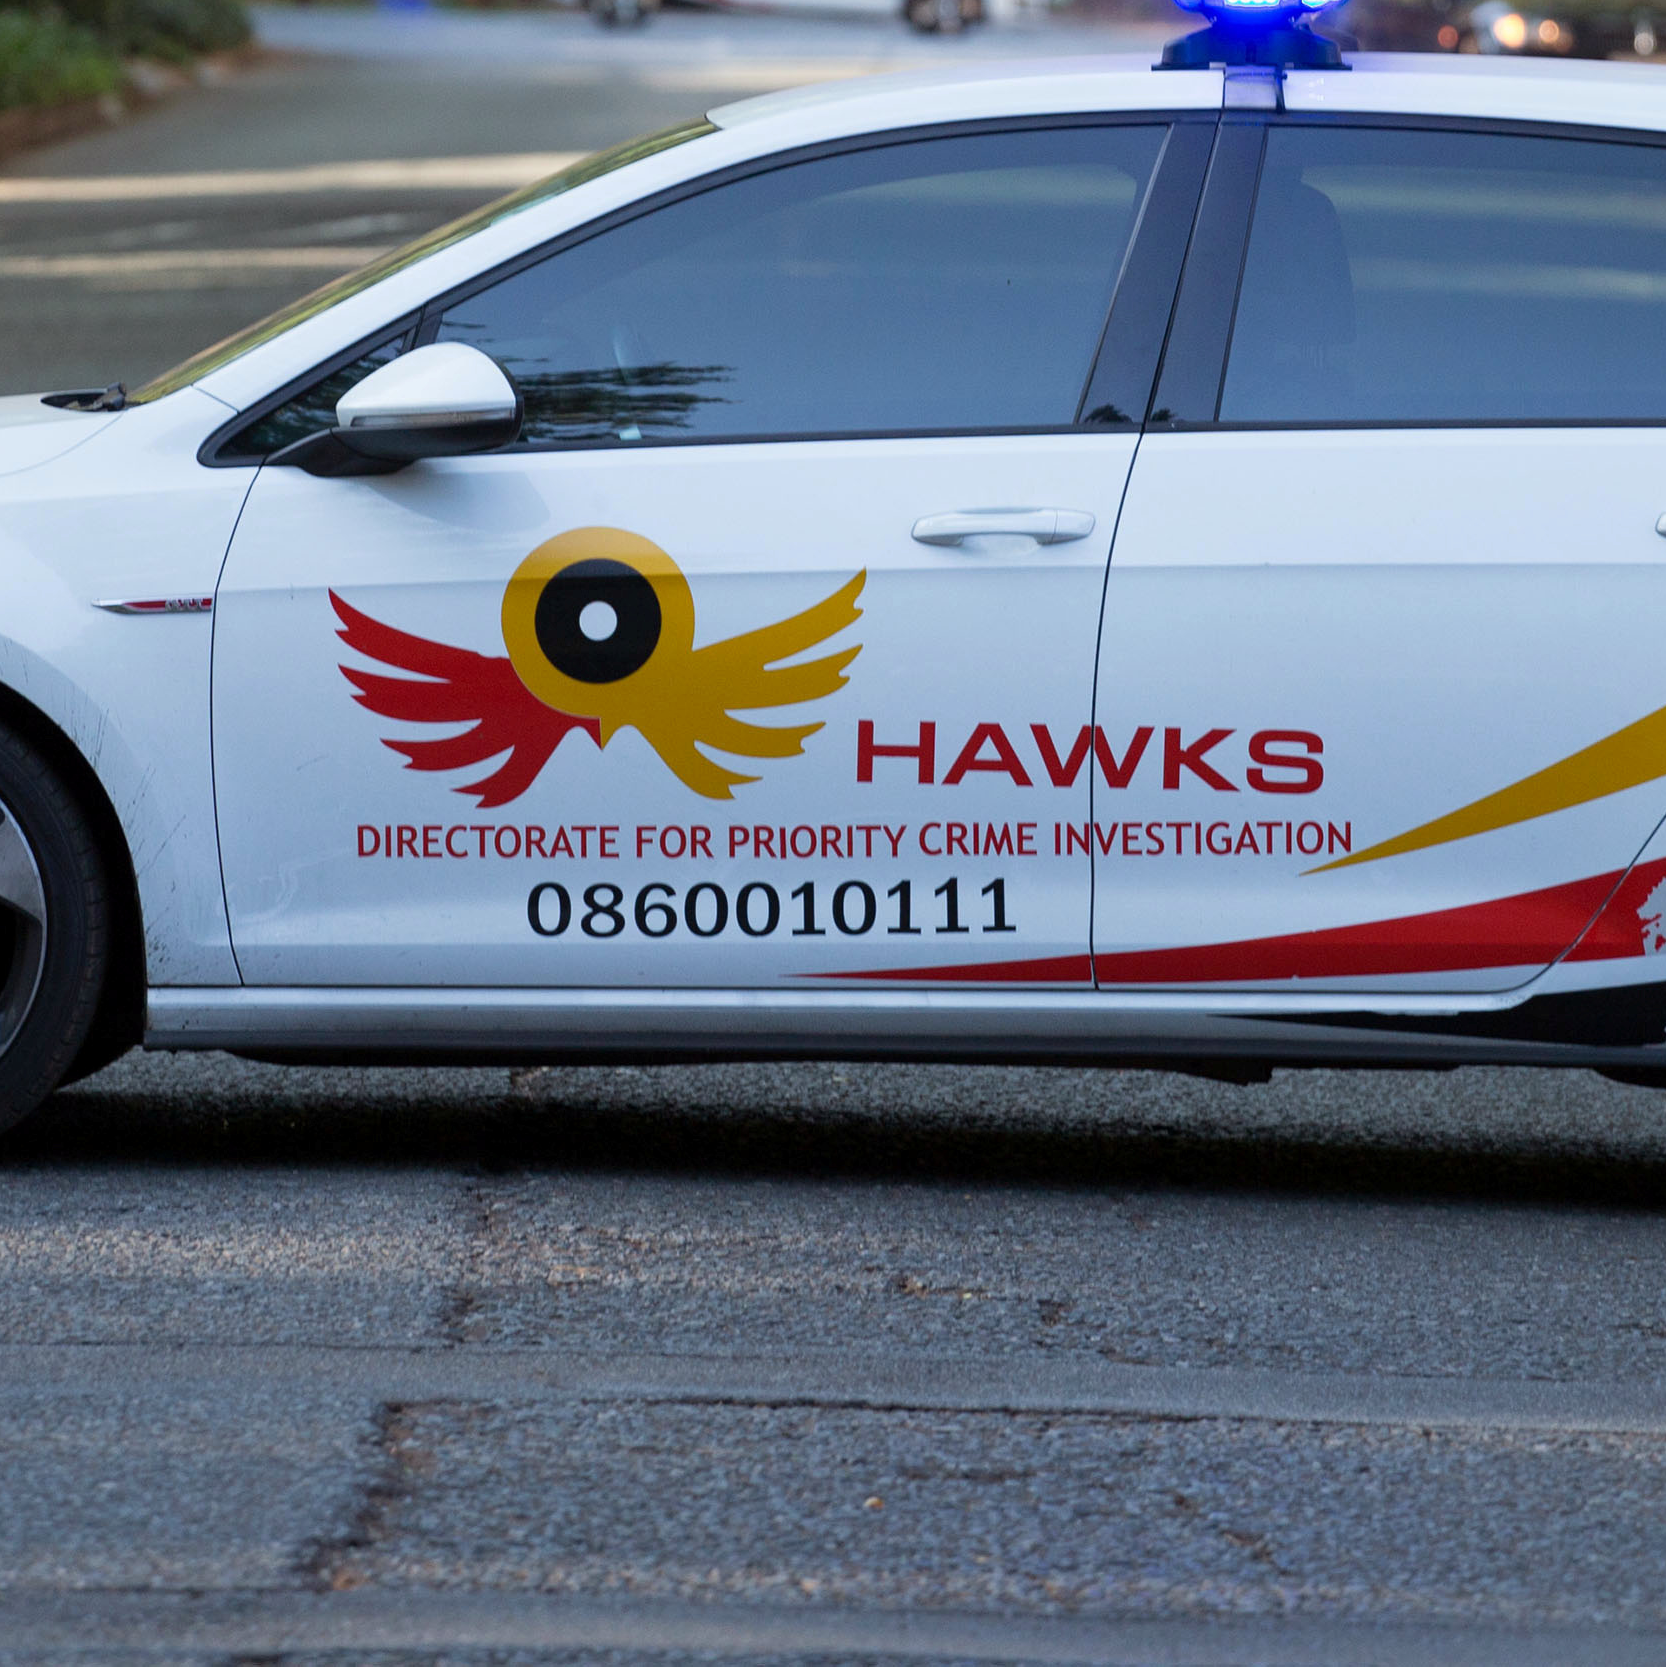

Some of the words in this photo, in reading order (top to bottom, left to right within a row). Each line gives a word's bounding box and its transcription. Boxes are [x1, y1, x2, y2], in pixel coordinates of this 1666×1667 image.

[856, 720, 1324, 795] HAWKS
[357, 823, 619, 859] DIRECTORATE
[636, 825, 712, 859] FOR
[729, 824, 906, 859] PRIORITY
[919, 821, 1037, 856] CRIME
[1054, 821, 1351, 856] INVESTIGATION
[527, 877, 1017, 938] 0860010111
